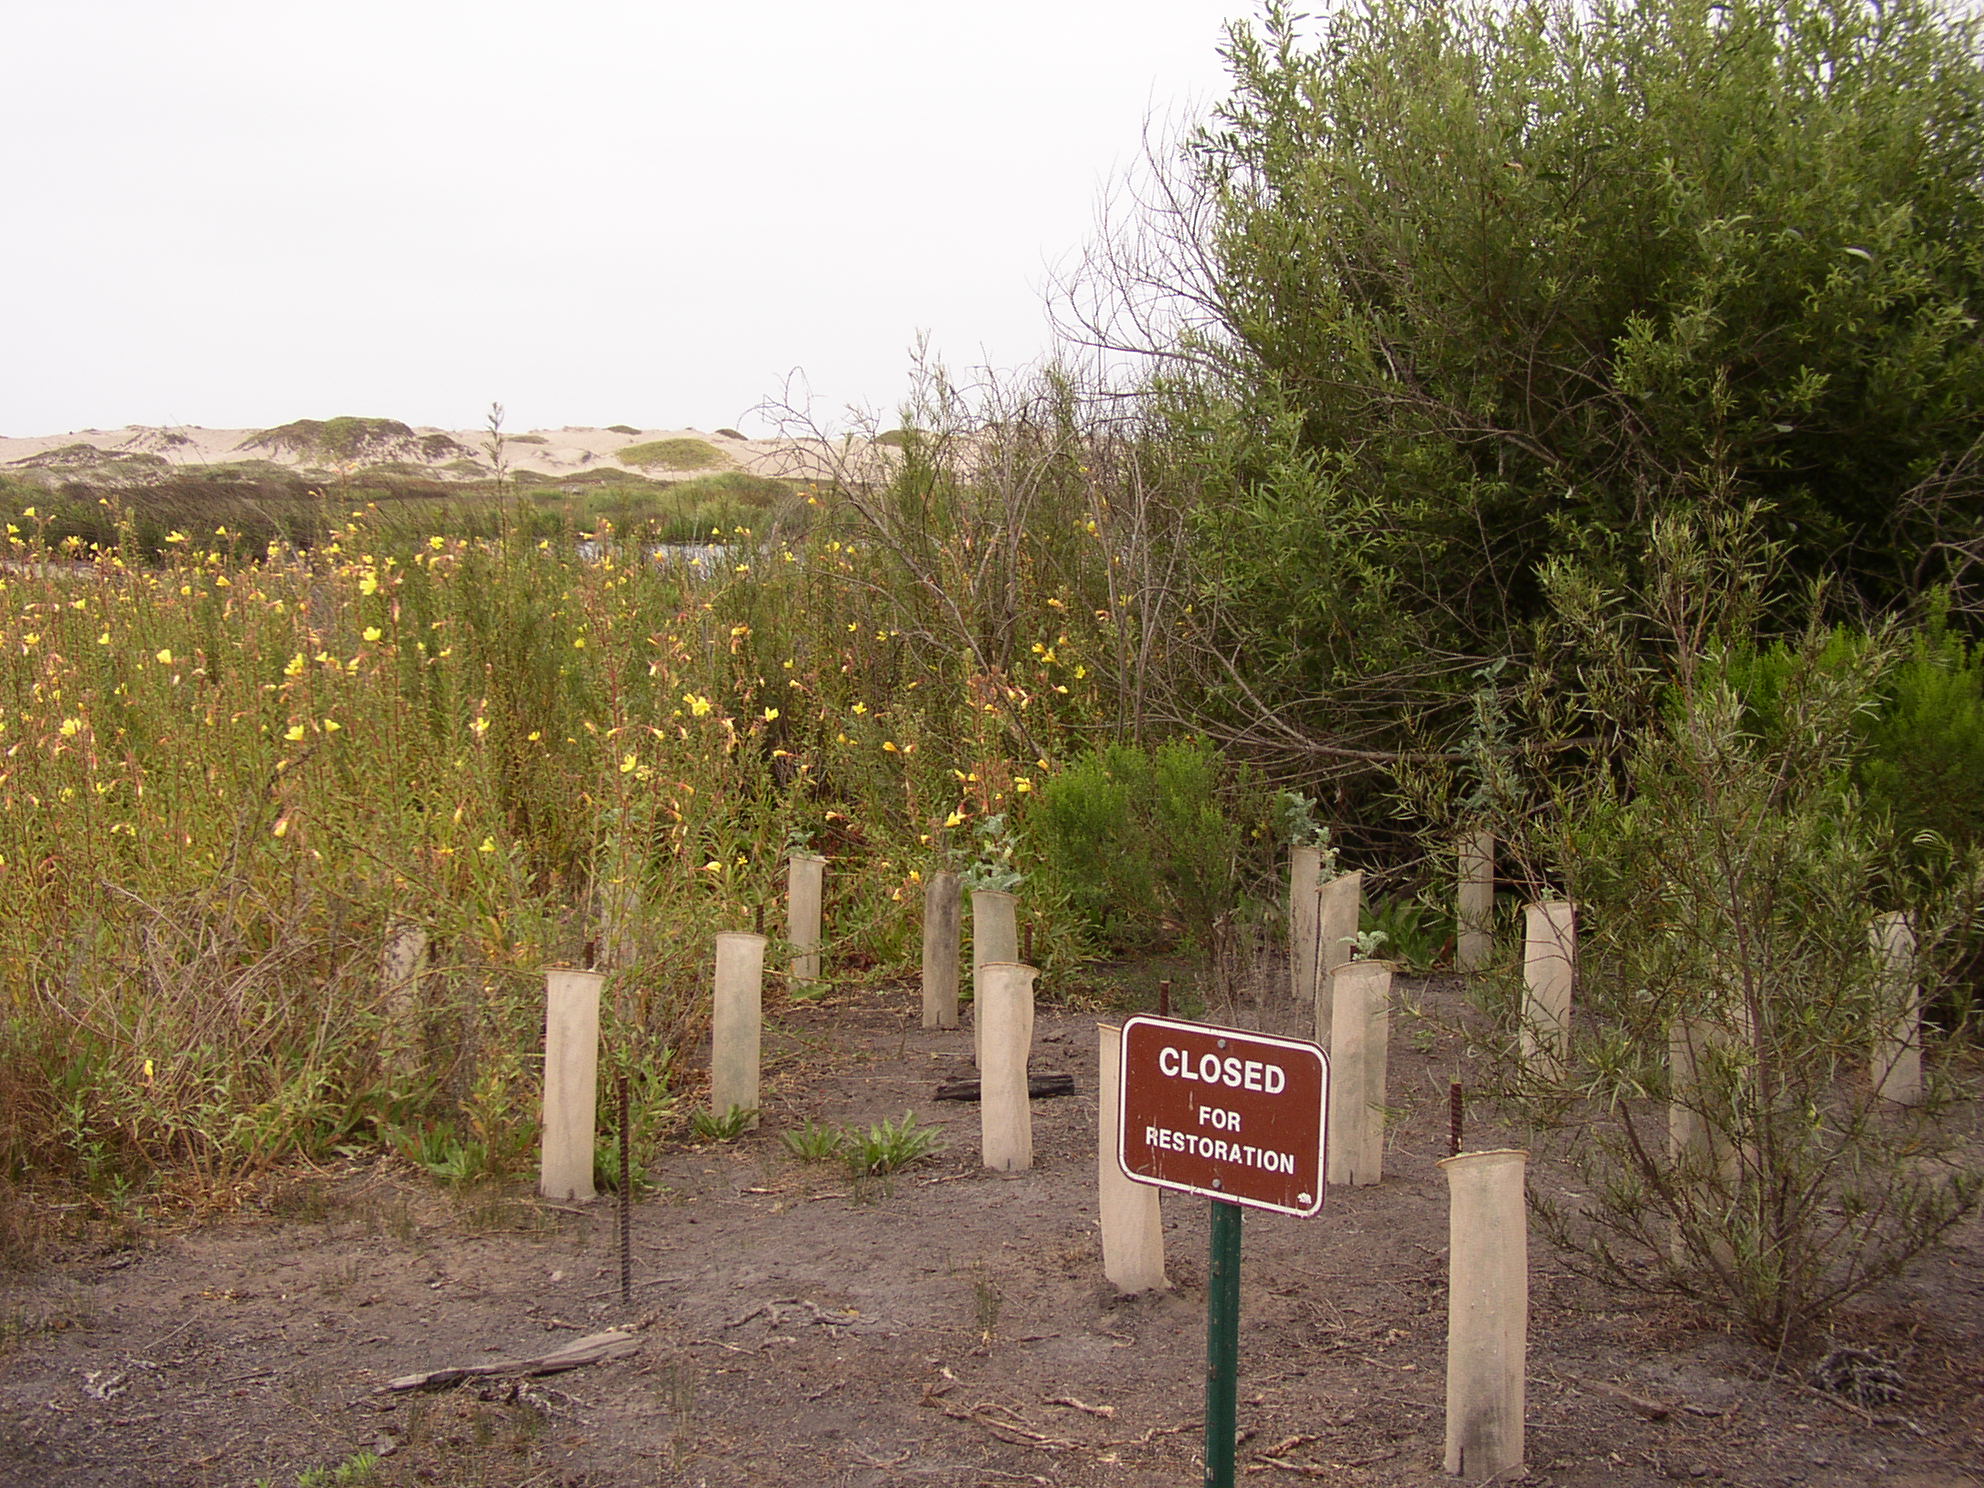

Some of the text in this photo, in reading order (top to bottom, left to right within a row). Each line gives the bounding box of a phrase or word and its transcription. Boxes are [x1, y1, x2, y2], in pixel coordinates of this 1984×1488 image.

[1159, 1047, 1286, 1094] CLOSED
[1199, 1105, 1241, 1132] FOR
[1145, 1126, 1295, 1175] RESTORATION
